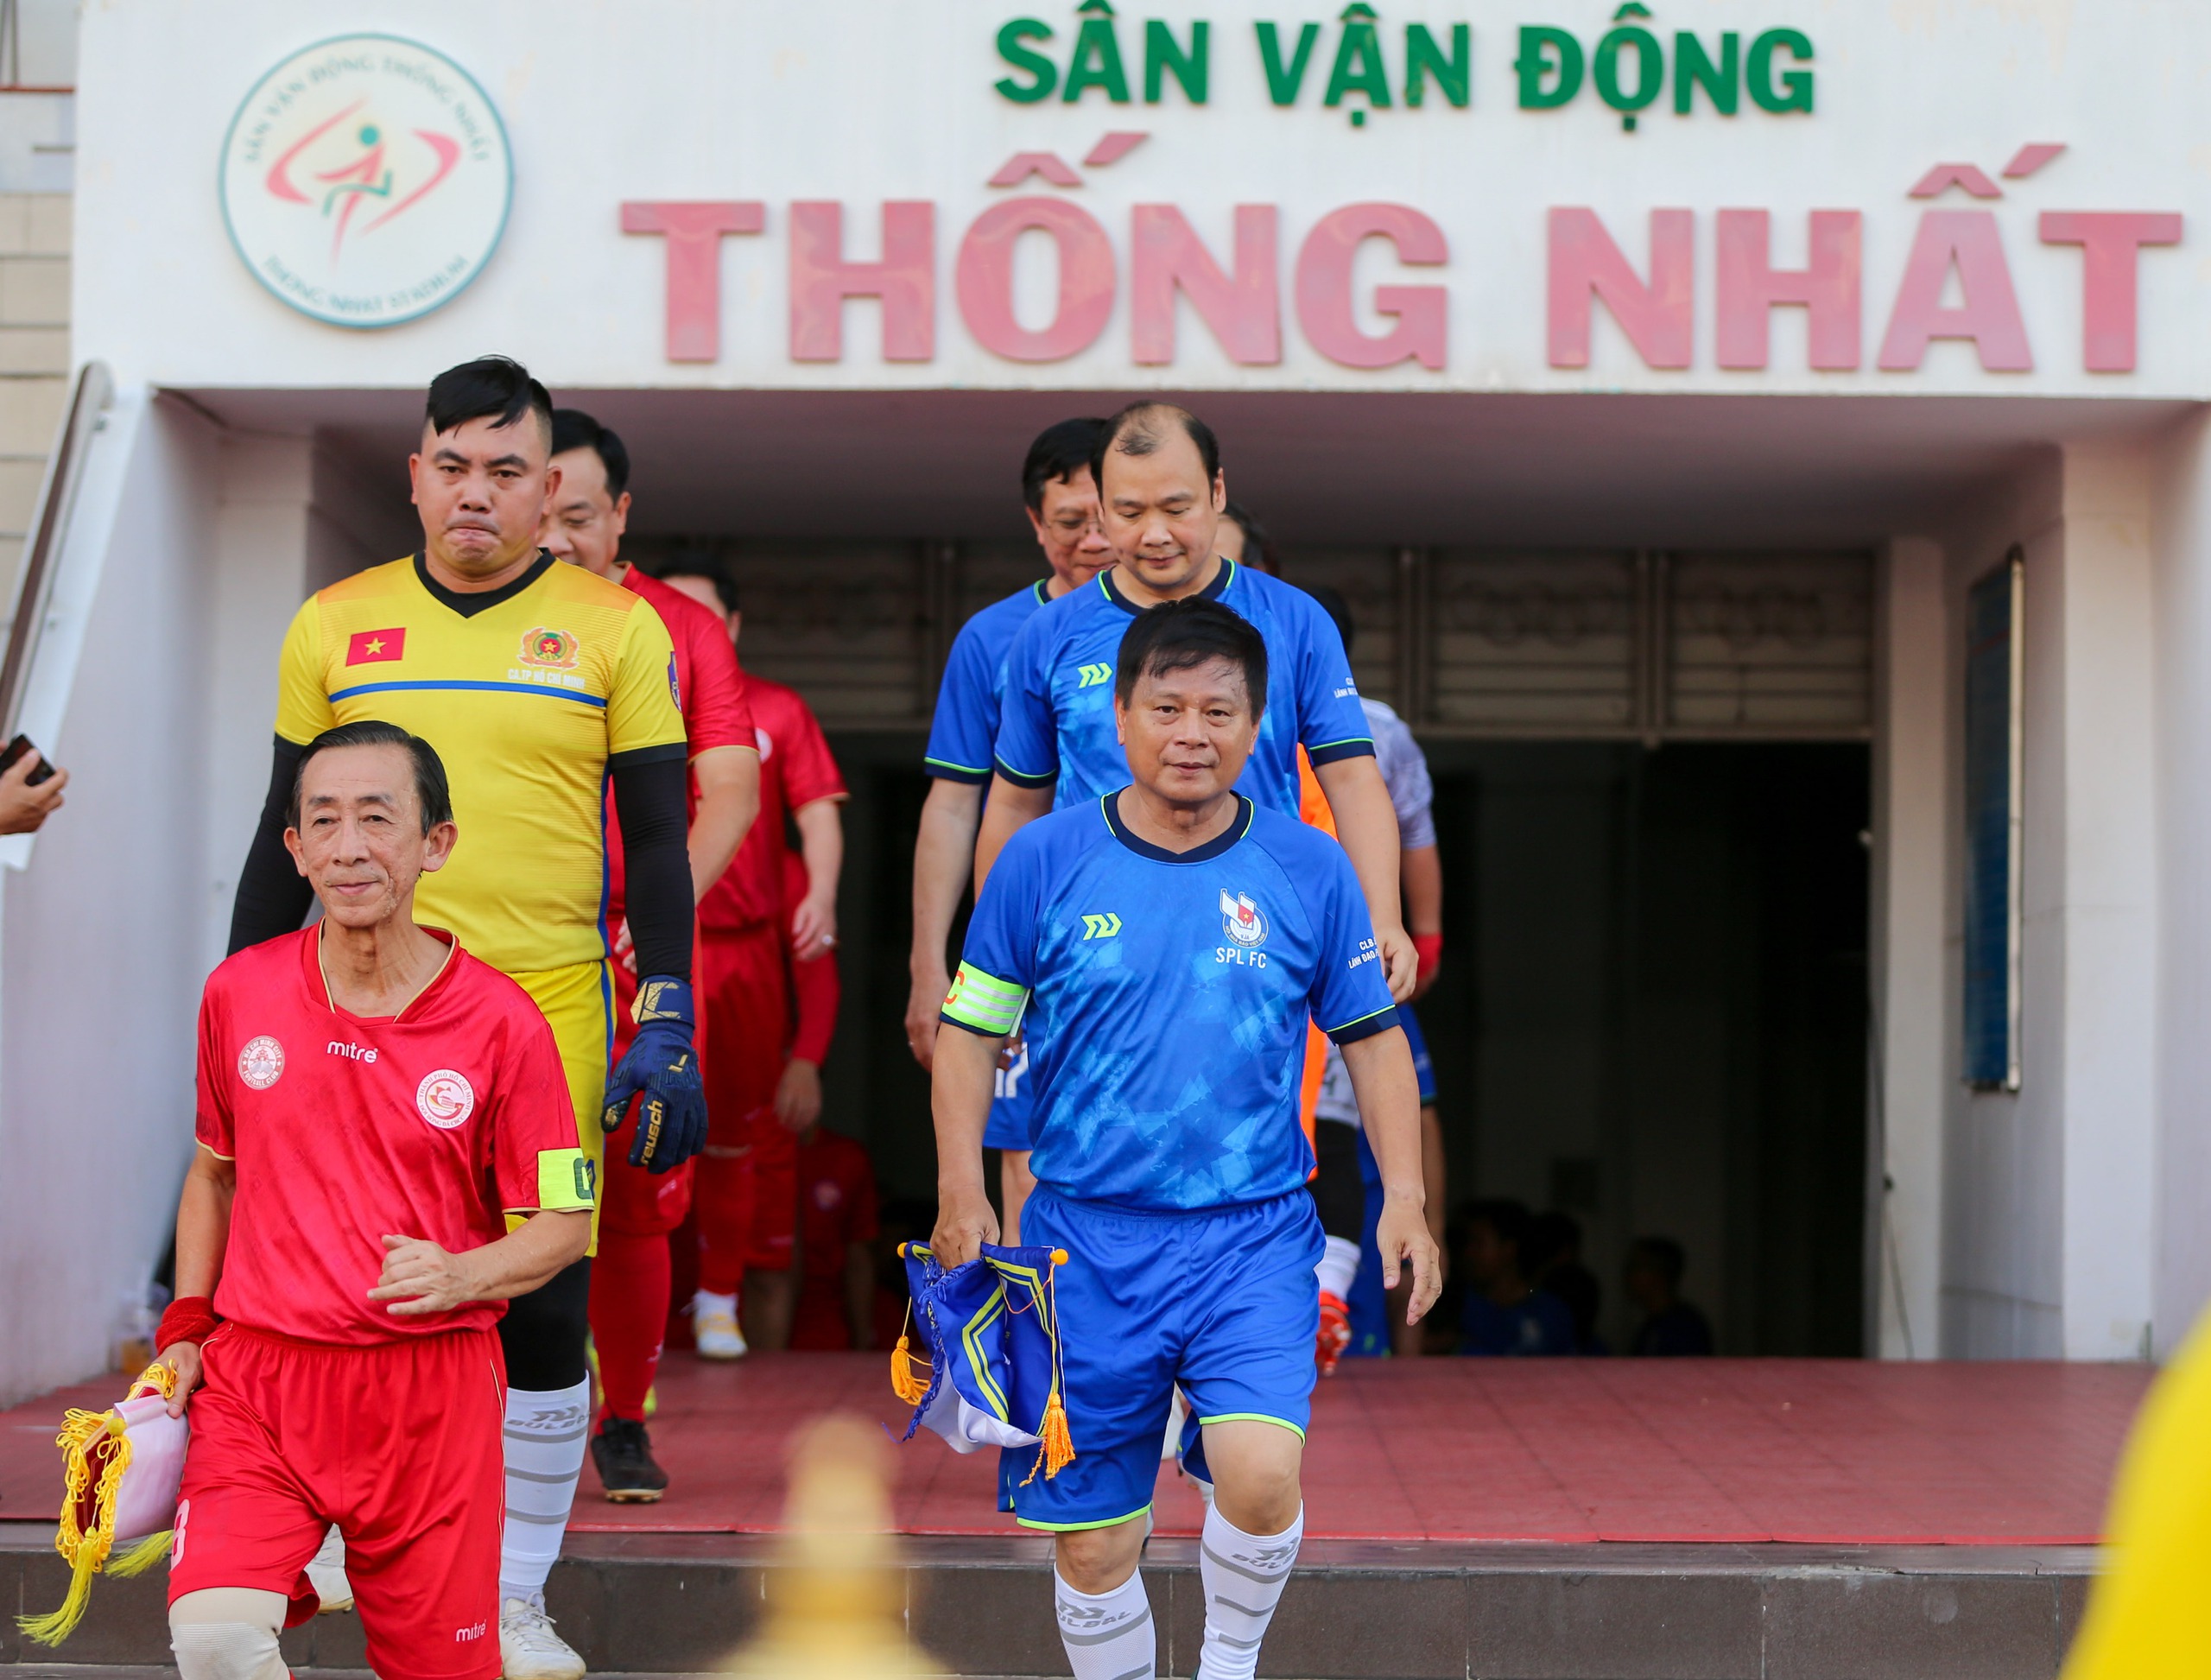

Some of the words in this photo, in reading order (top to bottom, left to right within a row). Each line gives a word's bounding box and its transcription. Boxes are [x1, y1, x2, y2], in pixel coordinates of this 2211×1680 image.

[994, 0, 1210, 104] SÂN
[1255, 2, 1472, 128] VẬN
[1514, 2, 1815, 131] ĐỘNG
[620, 131, 1450, 371] THỐNG
[1547, 143, 2183, 373] NHẤT
[1359, 938, 1374, 951] CLB
[1215, 947, 1245, 965] SPL
[1249, 951, 1267, 968] FC
[326, 1041, 379, 1064] mitre
[640, 1100, 663, 1166] reusch
[506, 1414, 591, 1430] BULBA
[455, 1619, 487, 1642] mitre
[1057, 1611, 1131, 1628] ULBAL
